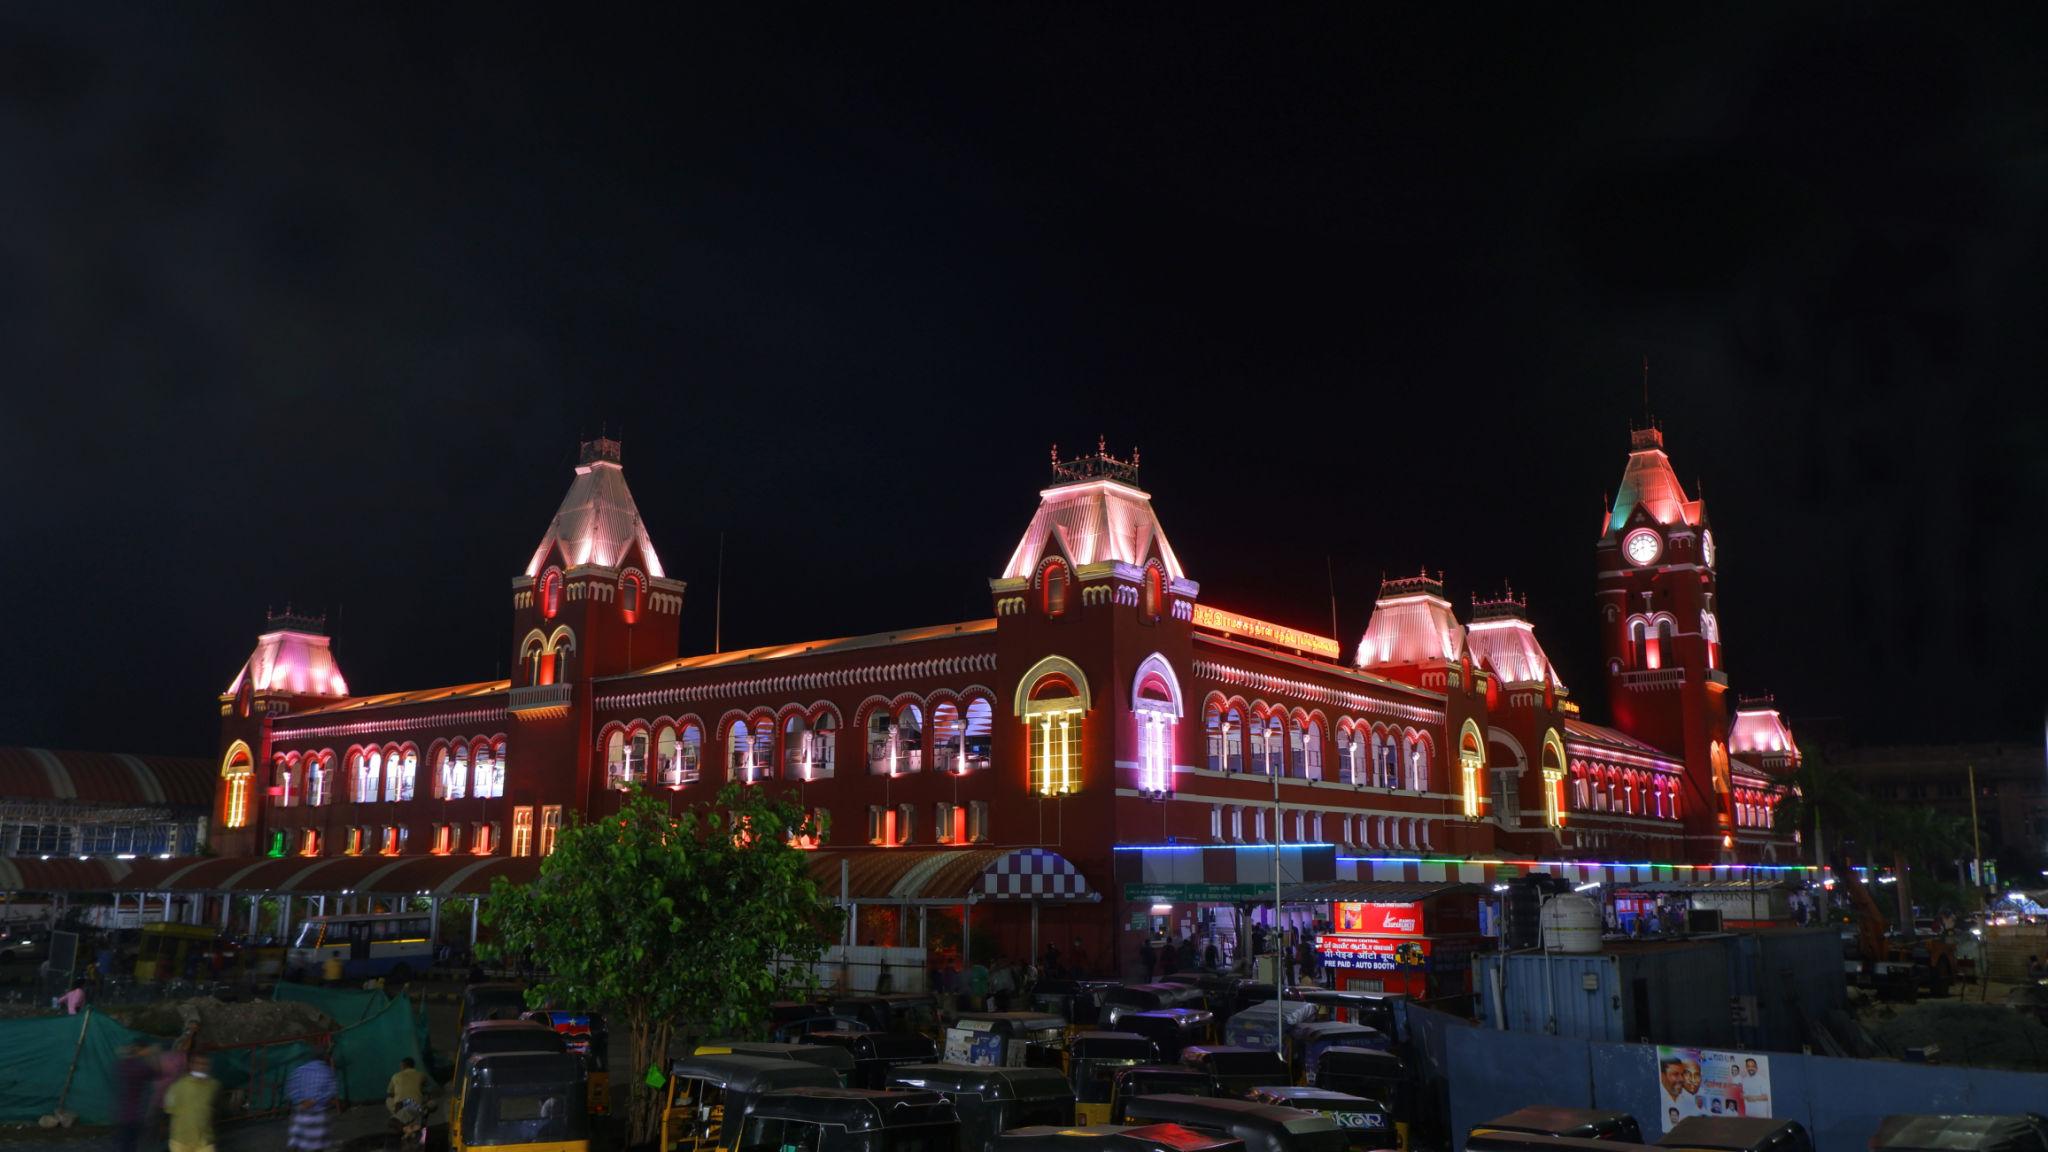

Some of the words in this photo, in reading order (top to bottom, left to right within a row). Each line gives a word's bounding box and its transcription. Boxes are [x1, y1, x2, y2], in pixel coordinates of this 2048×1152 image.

[1357, 950, 1377, 960] ऑटो
[1337, 960, 1351, 968] PAID
[1355, 961, 1372, 969] AUTO
[1373, 962, 1395, 970] BOOTH
